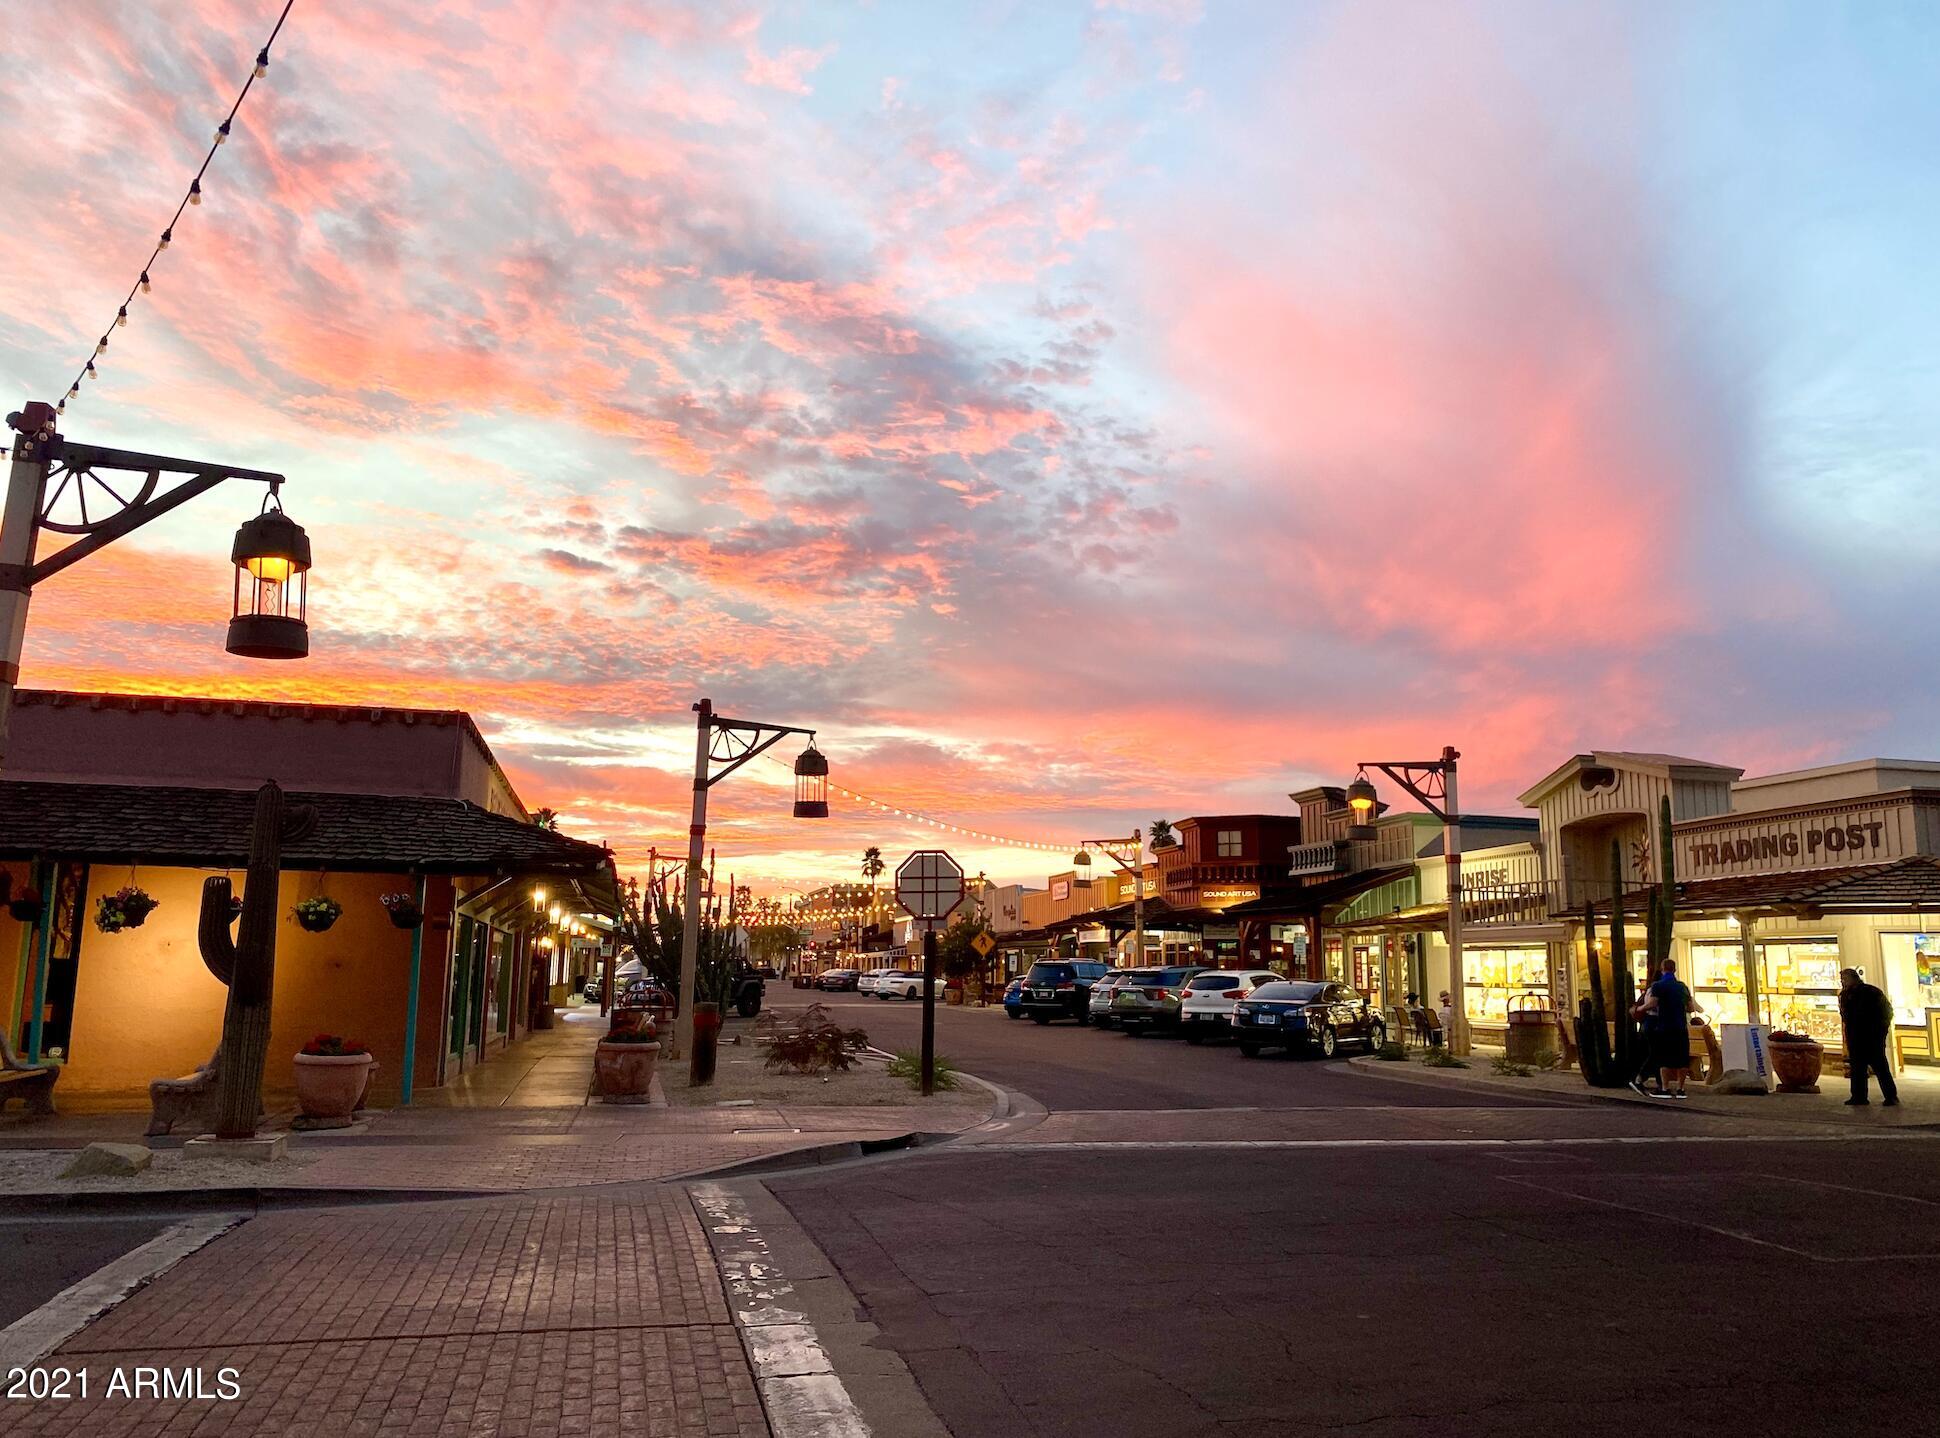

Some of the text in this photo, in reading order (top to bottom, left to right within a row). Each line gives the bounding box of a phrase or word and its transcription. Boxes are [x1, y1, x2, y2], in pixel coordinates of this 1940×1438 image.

[1689, 822, 1883, 867] TRADING POST
[1726, 964, 1795, 994] SLE
